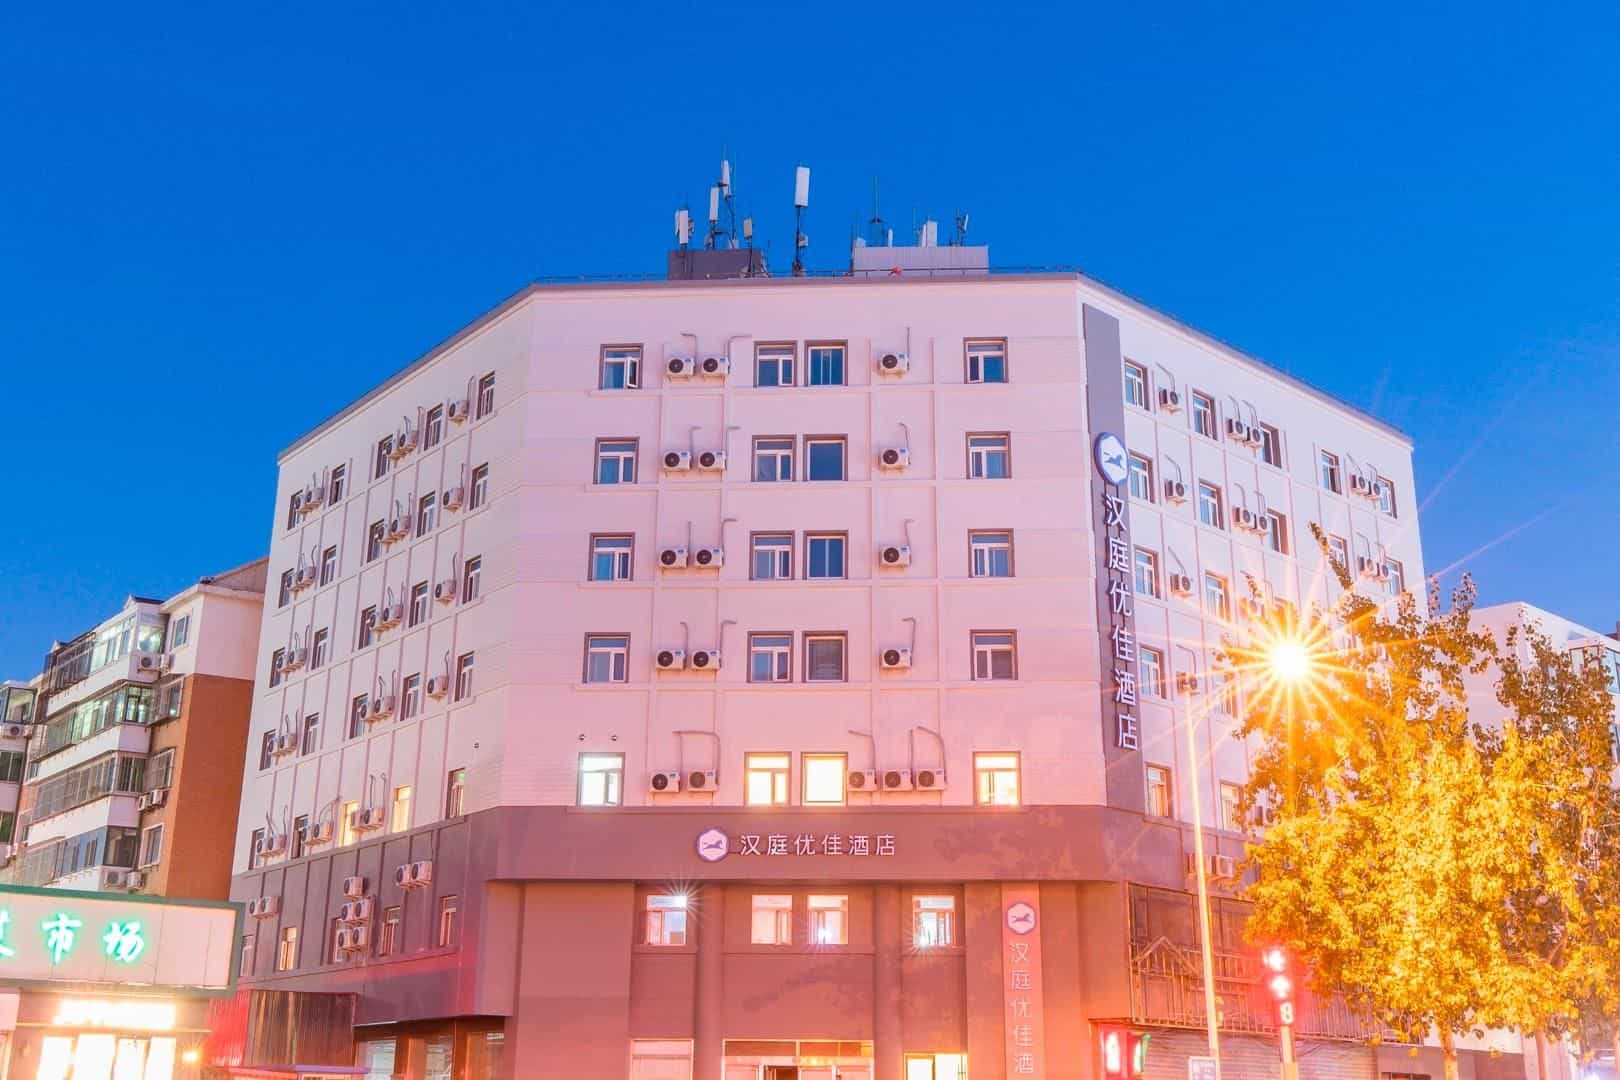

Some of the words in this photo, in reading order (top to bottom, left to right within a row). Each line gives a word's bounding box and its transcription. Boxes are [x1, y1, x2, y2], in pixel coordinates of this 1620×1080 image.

[1104, 493, 1139, 751] 汉庭优佳酒店
[740, 834, 896, 856] 汉庭优佳酒店
[1008, 943, 1034, 1074] 汉庭优佳酒
